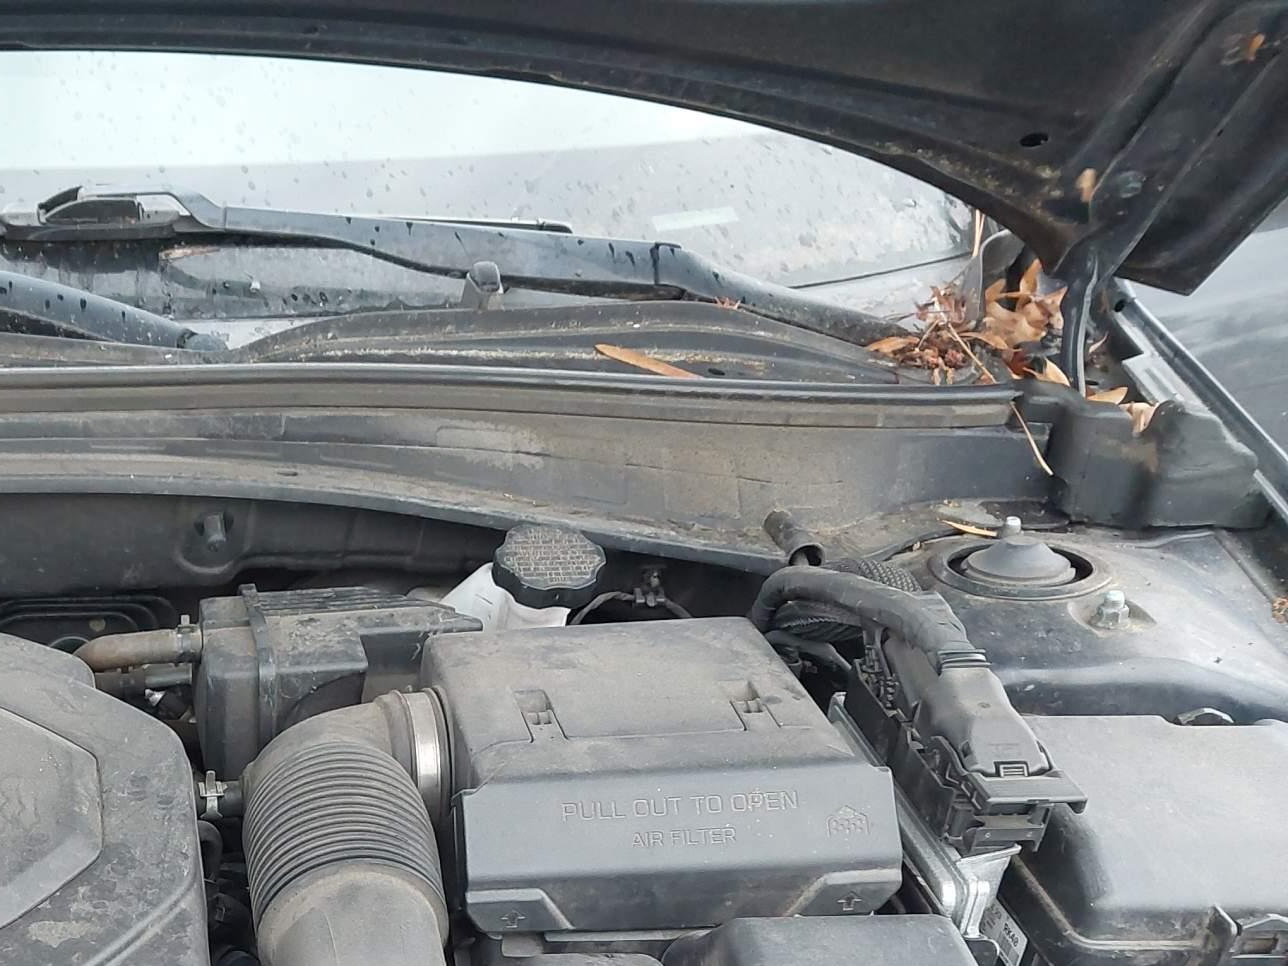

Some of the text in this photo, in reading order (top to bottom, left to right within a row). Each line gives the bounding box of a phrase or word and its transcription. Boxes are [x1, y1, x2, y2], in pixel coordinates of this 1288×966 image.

[562, 790, 799, 823] PULL OUT TO OPEN
[631, 825, 737, 850] AIR FILTER
